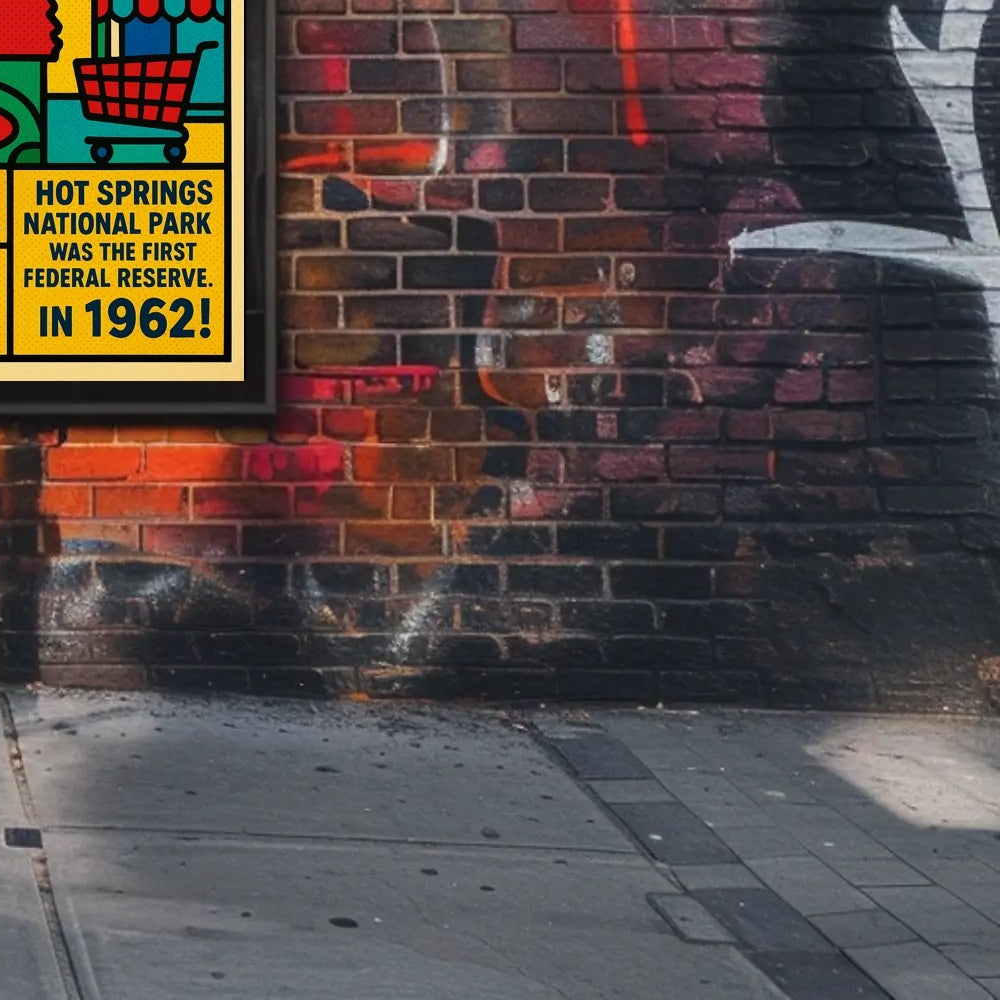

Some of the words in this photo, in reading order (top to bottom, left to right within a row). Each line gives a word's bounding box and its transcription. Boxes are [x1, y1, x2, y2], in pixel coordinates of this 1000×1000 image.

[37, 180, 90, 206] HOT
[97, 179, 213, 206] SPRINGS
[24, 212, 142, 235] NATIONAL
[149, 211, 212, 235] PARK
[50, 242, 93, 261] WAS
[100, 242, 136, 261] THE
[143, 242, 197, 261] FIRST
[24, 268, 111, 288] FEDERAL
[118, 267, 213, 288] RESERVE.
[39, 305, 73, 337] IN
[85, 297, 211, 339] 1962!
